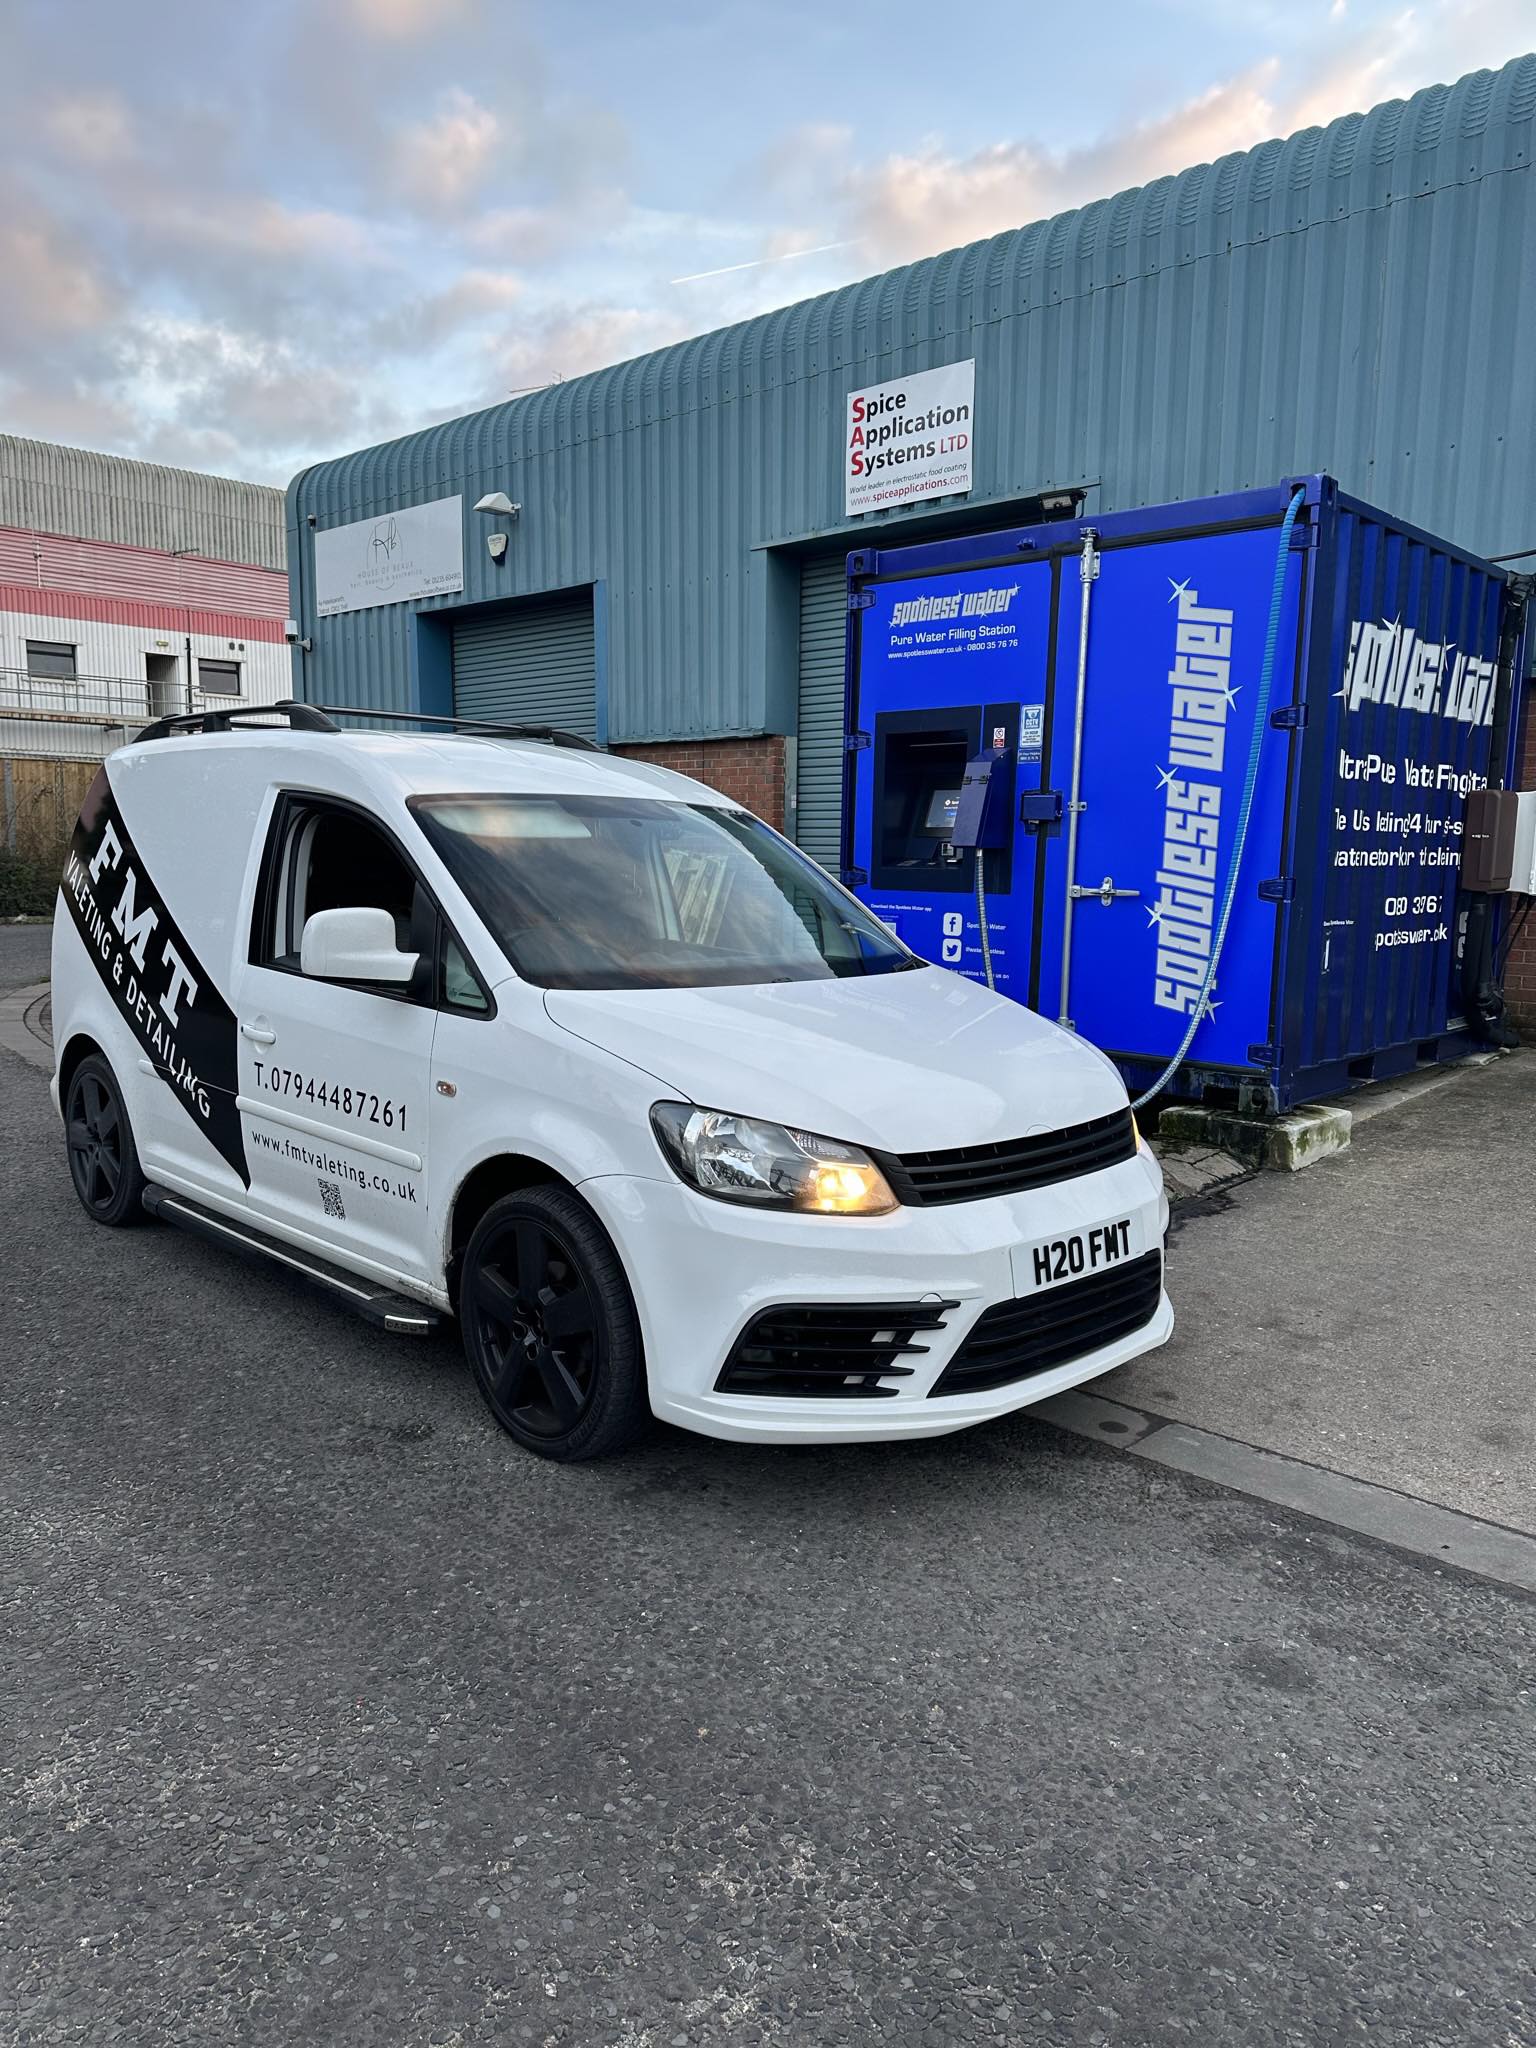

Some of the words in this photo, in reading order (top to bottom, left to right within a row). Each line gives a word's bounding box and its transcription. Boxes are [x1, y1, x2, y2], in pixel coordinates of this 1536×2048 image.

[850, 404, 969, 449] Application
[852, 393, 906, 423] Spice
[851, 440, 936, 477] Systems
[940, 434, 968, 455] LTD
[850, 485, 867, 494] World
[868, 481, 885, 490] leader
[892, 471, 928, 485] electrostatic
[928, 467, 943, 477] food
[944, 463, 967, 473] coating
[851, 474, 969, 506] www.spiceapplications.com
[892, 595, 961, 627] spotless
[962, 588, 1018, 616] water
[888, 645, 962, 659] www.spotlesswater.co.uk
[967, 642, 985, 651] 0800
[986, 641, 996, 649] 35
[998, 640, 1007, 648] 76
[1009, 639, 1018, 647] 76
[891, 634, 913, 646] Pure
[915, 631, 946, 643] Water
[949, 628, 976, 640] Filling
[979, 624, 1016, 636] Station
[1168, 590, 1234, 772] water
[1154, 778, 1222, 1017] spotless
[89, 819, 199, 1030] FMT
[67, 849, 112, 961] VALETING
[113, 952, 123, 985] &
[126, 975, 211, 1118] DETAILING
[254, 1061, 406, 1131] T.07944487261
[252, 1131, 416, 1203] www.fmtvaleting.co.uk
[1089, 1219, 1131, 1267] FMT
